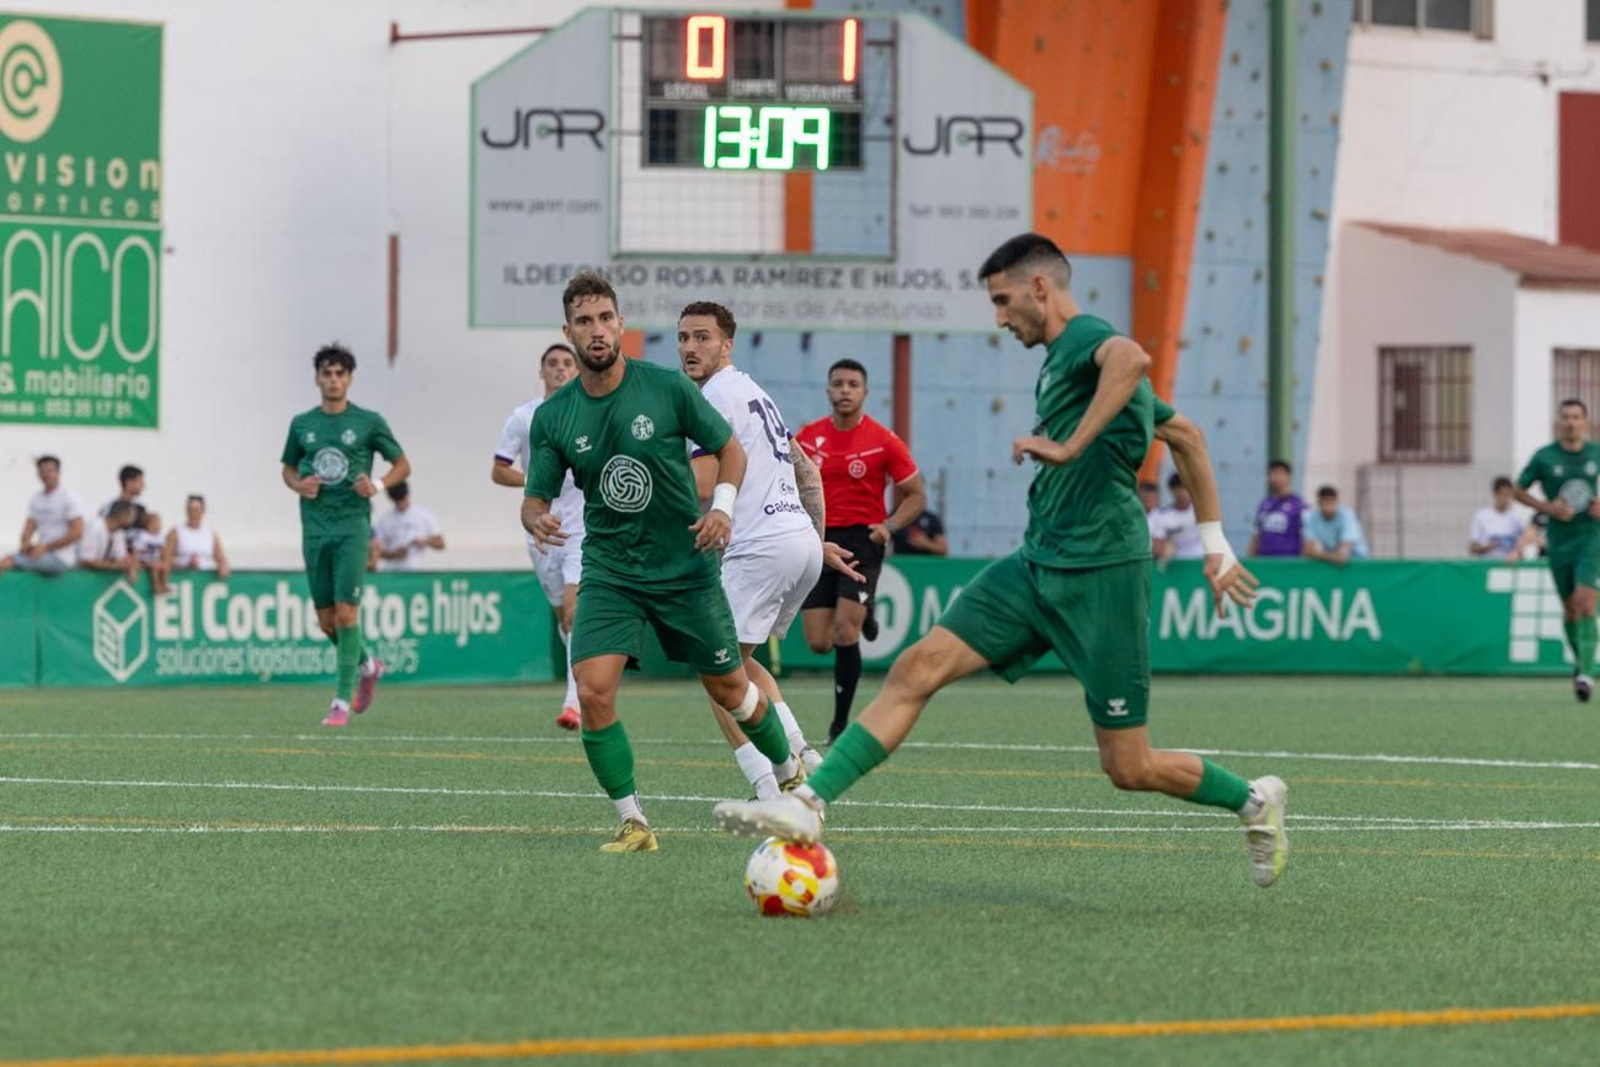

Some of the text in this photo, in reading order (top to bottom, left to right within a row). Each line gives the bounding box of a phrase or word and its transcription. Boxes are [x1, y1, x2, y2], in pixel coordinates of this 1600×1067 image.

[686, 15, 726, 80] 0
[843, 19, 857, 82] 1
[481, 106, 605, 150] JAR
[704, 106, 831, 170] 13:09
[903, 114, 1024, 158] JAR
[656, 265, 725, 288] ROSA
[852, 267, 865, 289] E
[832, 300, 947, 321] Aceitunas
[24, 364, 150, 399] mobiliario
[154, 580, 194, 640] El
[409, 592, 429, 635] e
[433, 579, 502, 647] hijos
[156, 642, 245, 676] soluciones
